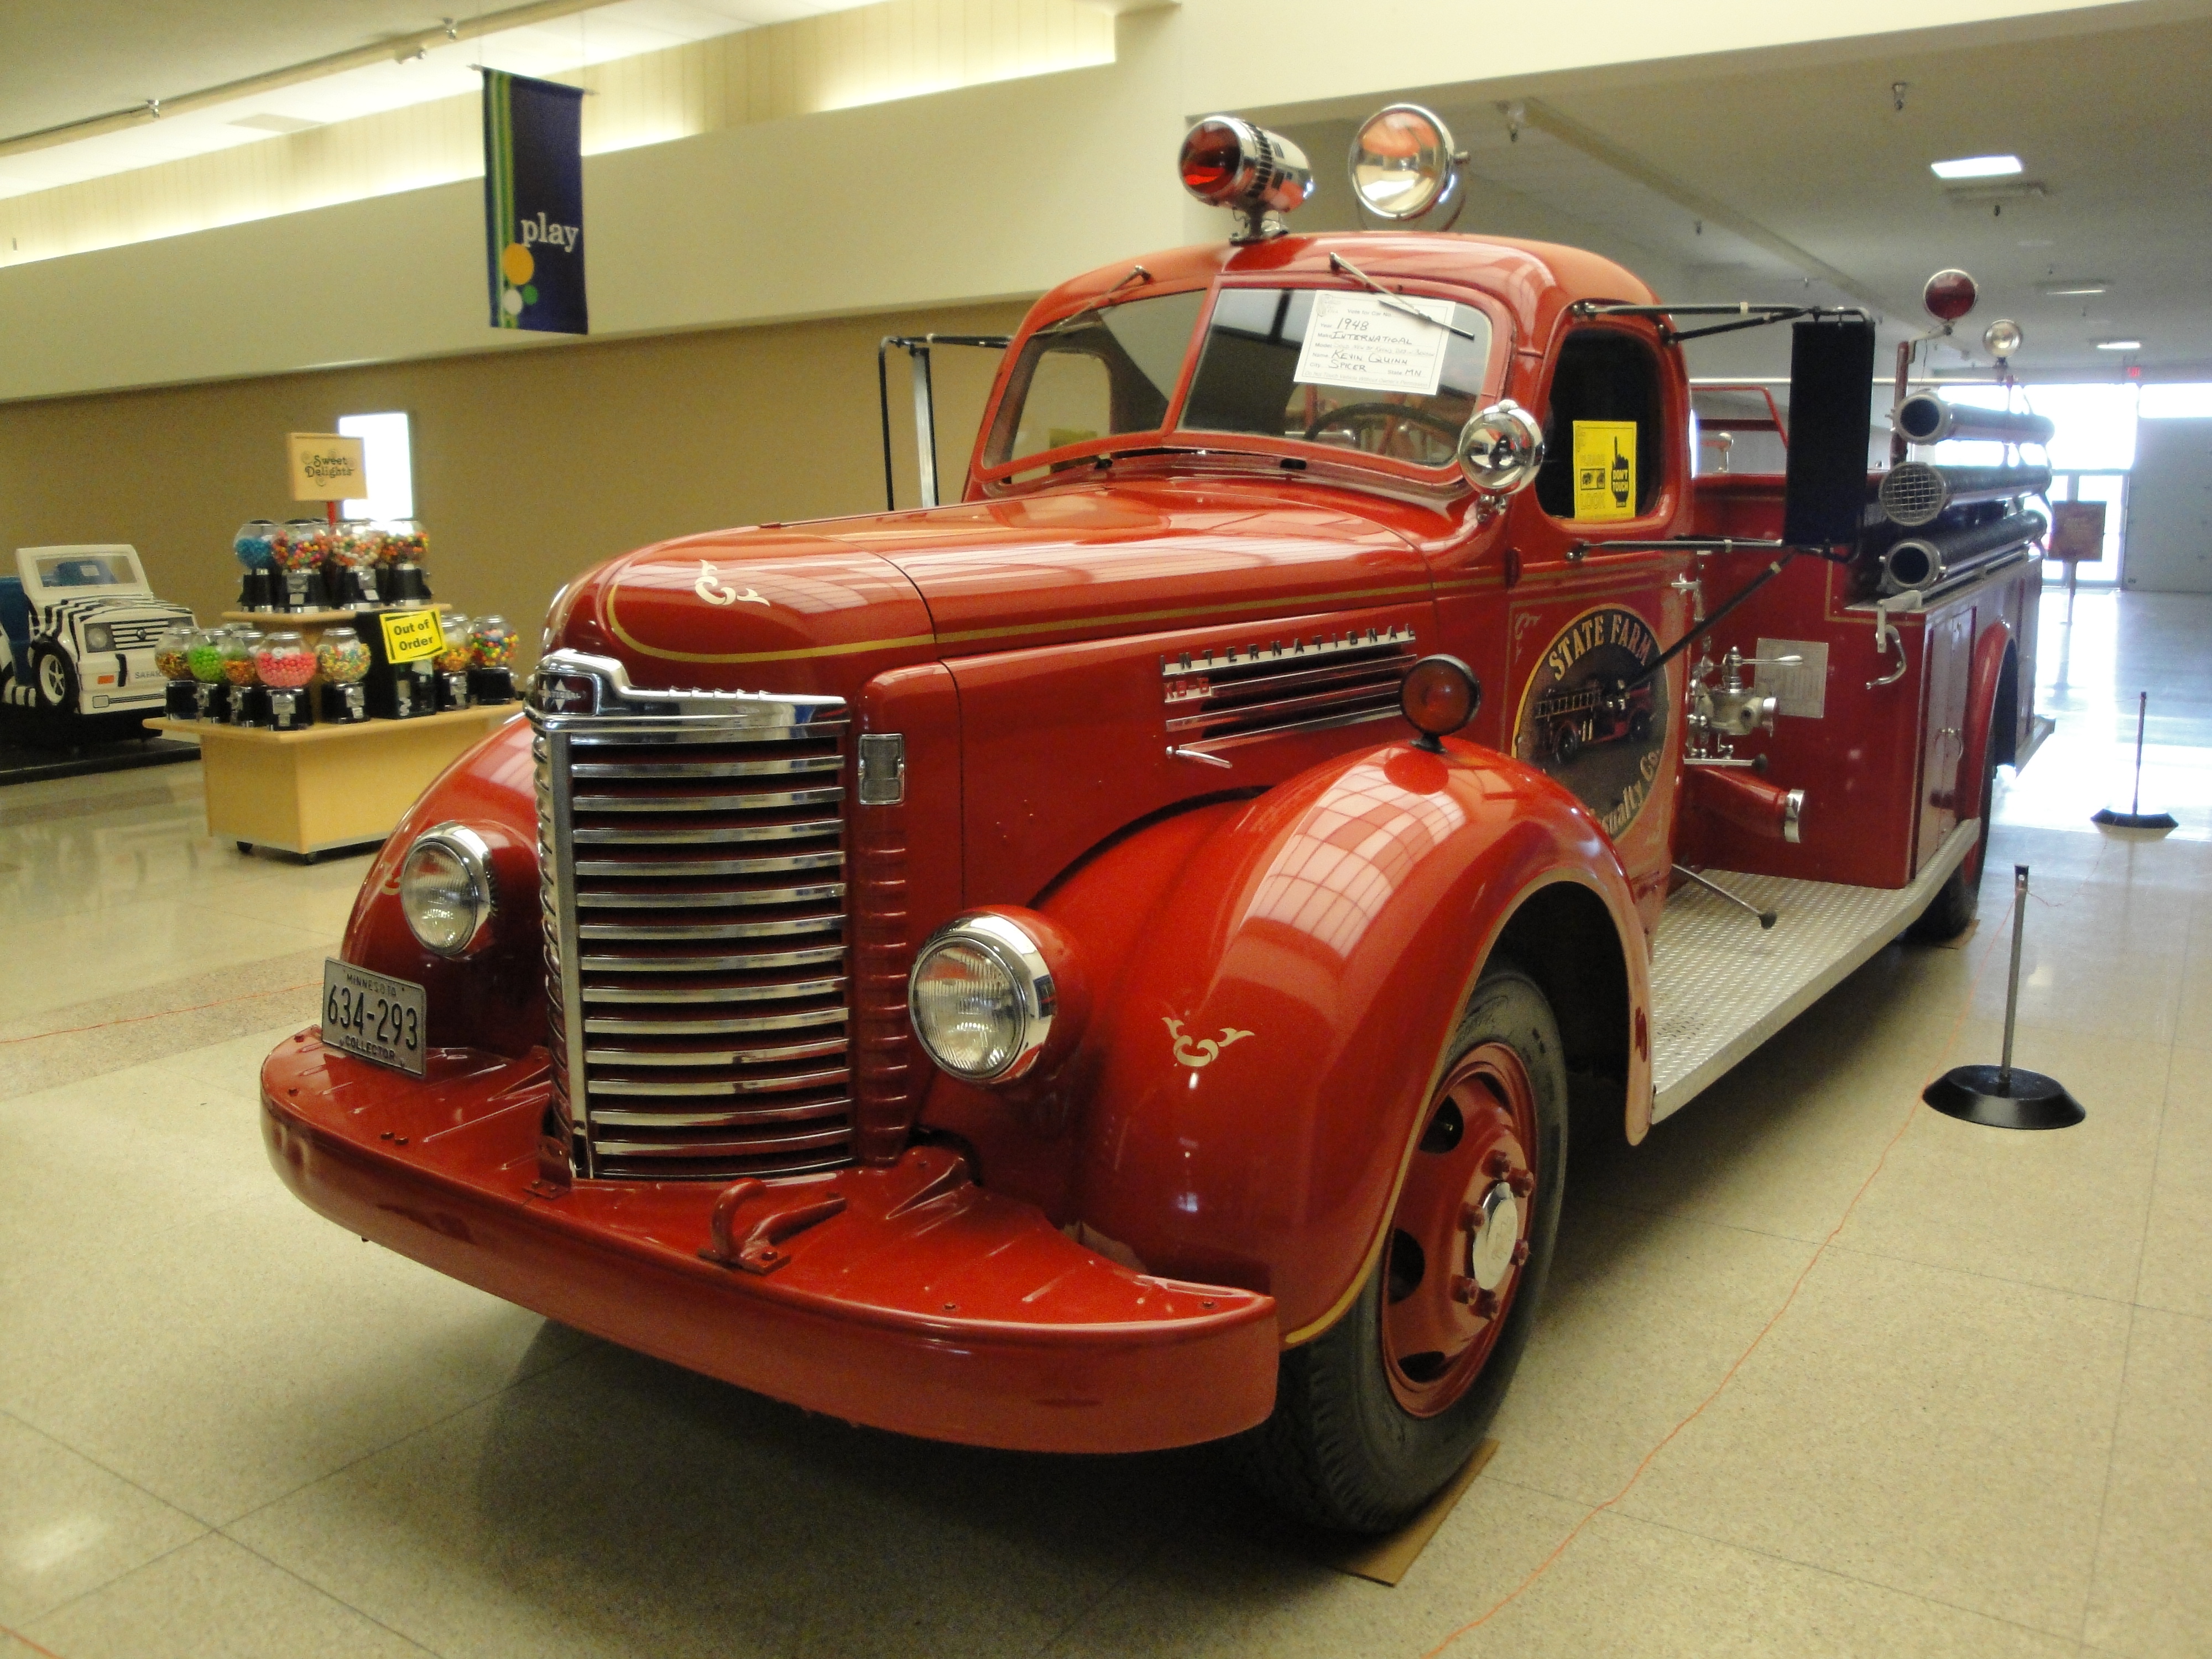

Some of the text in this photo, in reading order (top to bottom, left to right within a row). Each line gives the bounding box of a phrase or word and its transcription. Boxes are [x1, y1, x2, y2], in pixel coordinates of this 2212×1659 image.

[520, 211, 580, 253] play
[1337, 317, 1369, 331] 1948
[1332, 349, 1363, 361] KEVIN
[1369, 353, 1408, 365] QUINN
[1328, 359, 1367, 372] SPICER
[314, 455, 347, 467] Sweet
[305, 466, 354, 478] Delights
[394, 619, 430, 635] Out of
[399, 637, 433, 651] Order
[1160, 623, 1415, 673] INTERNATIONAL
[1548, 614, 1652, 681] STATE FARM
[346, 973, 397, 995] MINNESOTA
[328, 983, 418, 1051] 634-293
[345, 1035, 396, 1061] COLLECTOR
